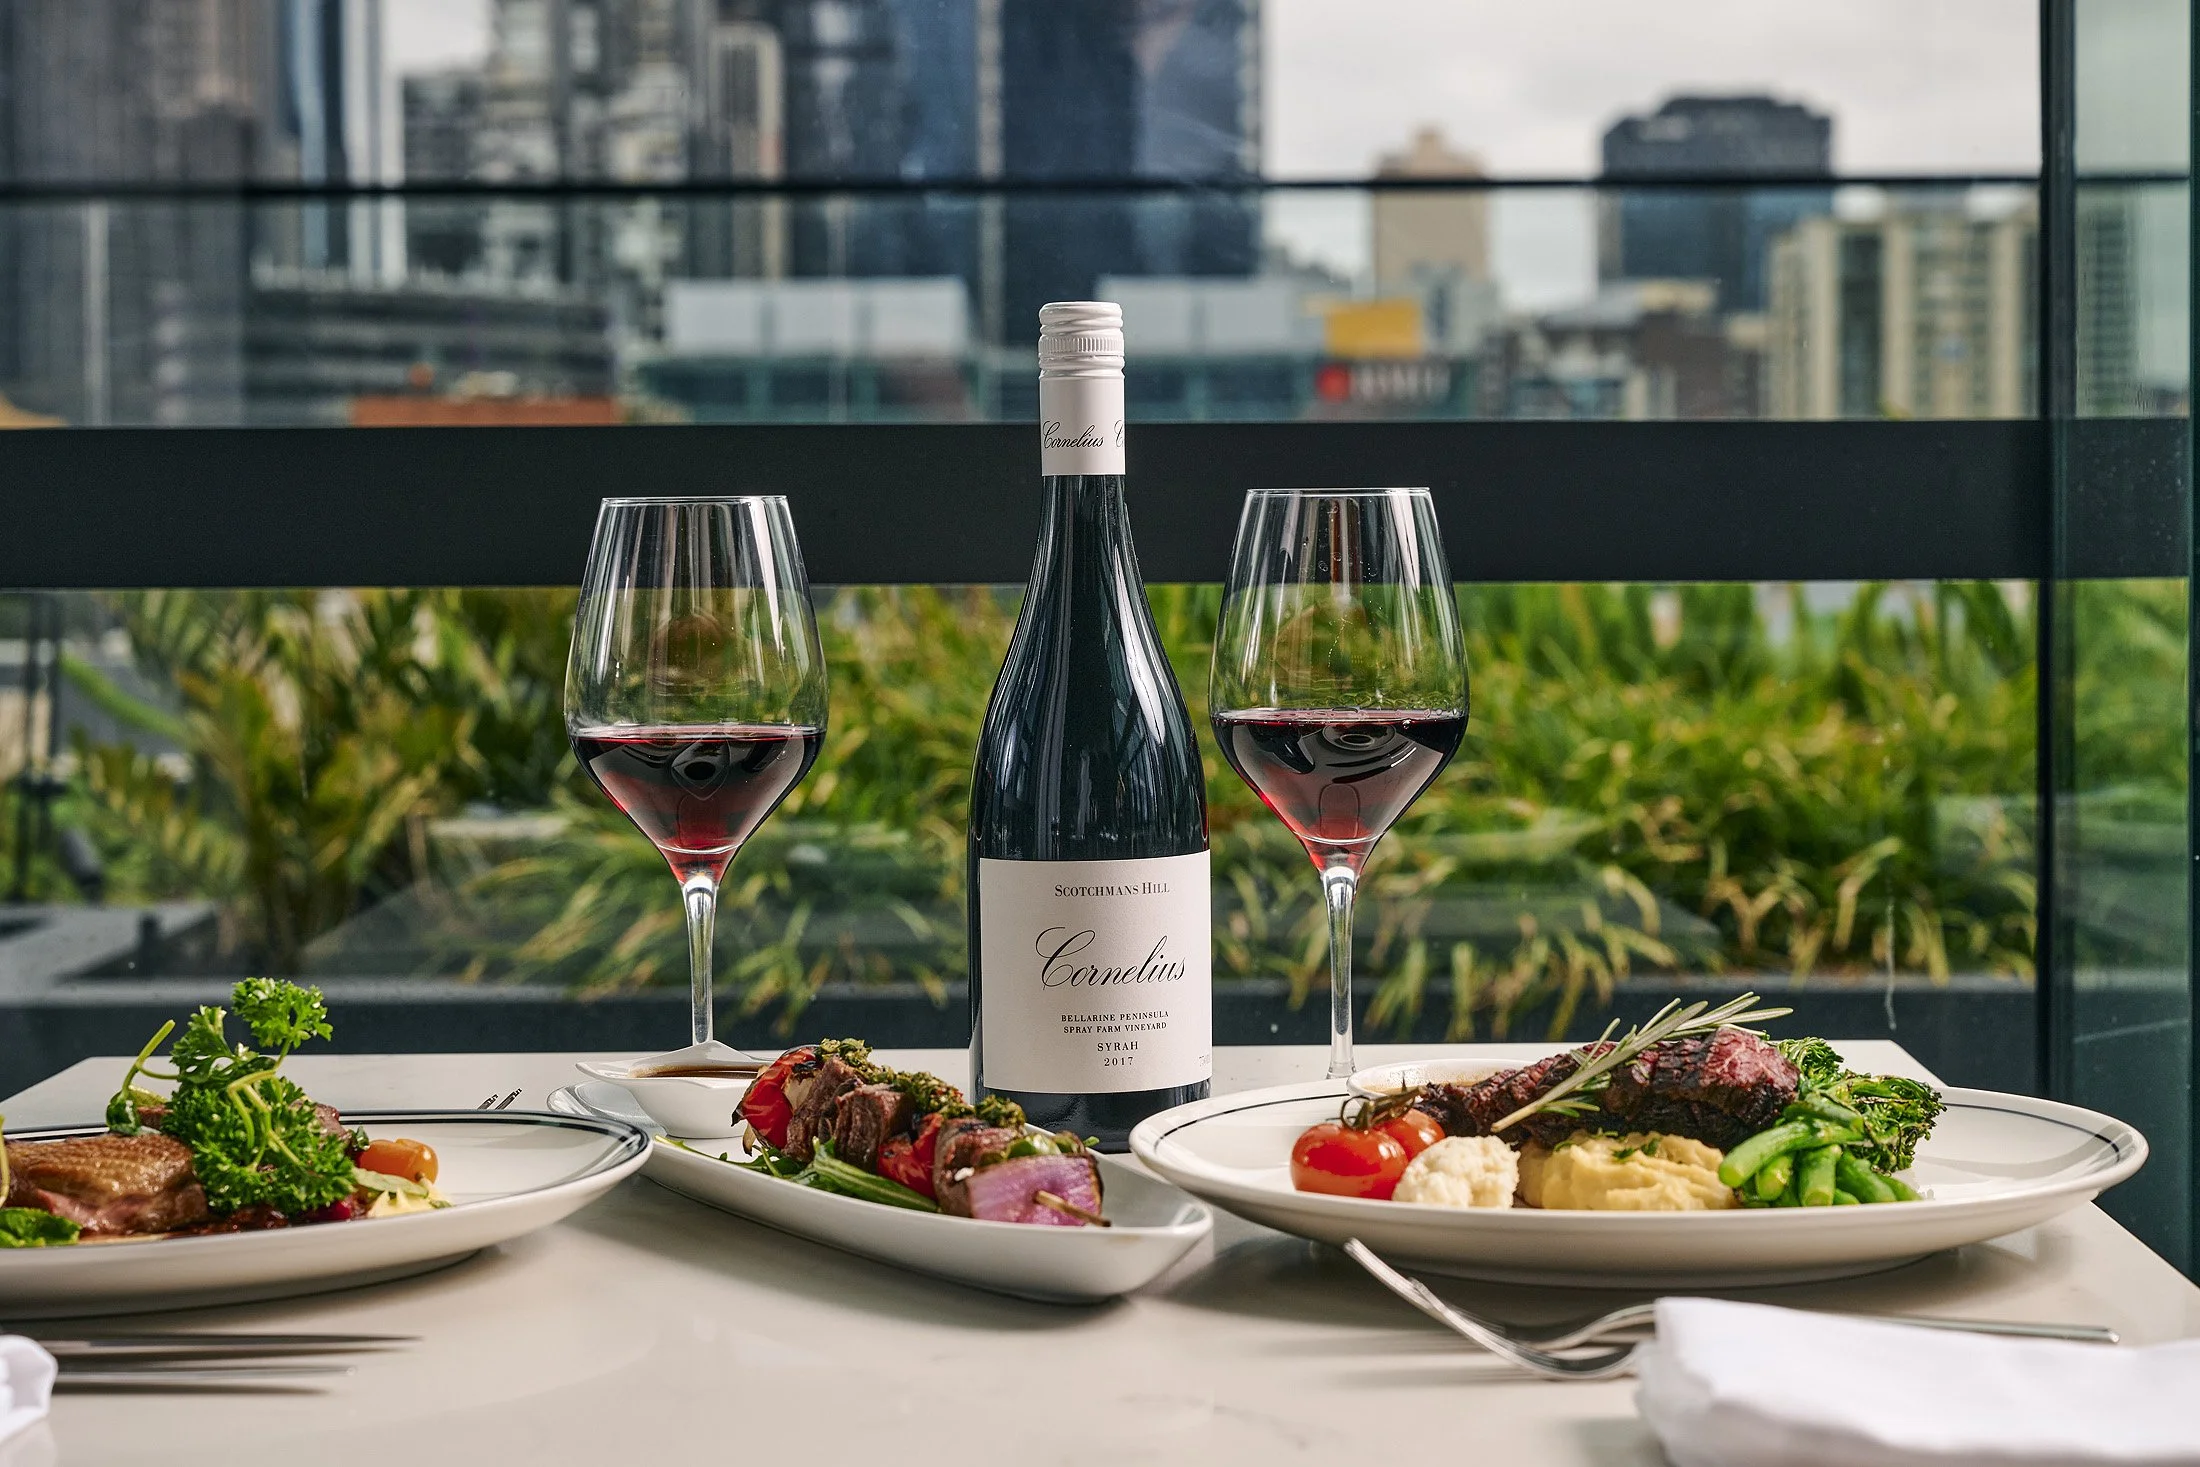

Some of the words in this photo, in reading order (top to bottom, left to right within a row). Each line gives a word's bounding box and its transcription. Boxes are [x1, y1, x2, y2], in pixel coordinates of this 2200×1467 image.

[1042, 420, 1104, 449] Cornelius
[1054, 884, 1139, 898] SCOTCHMANS
[1142, 881, 1170, 895] HILL
[1035, 926, 1186, 991] Cornelius
[1061, 1013, 1116, 1023] BELLARINE
[1119, 1010, 1169, 1021] PENINSULA
[1063, 1026, 1093, 1034] SPRAY
[1096, 1025, 1121, 1034] FARM
[1125, 1021, 1167, 1032] VINEYARD
[1097, 1041, 1138, 1052] SYRAH
[1103, 1056, 1134, 1067] 2017
